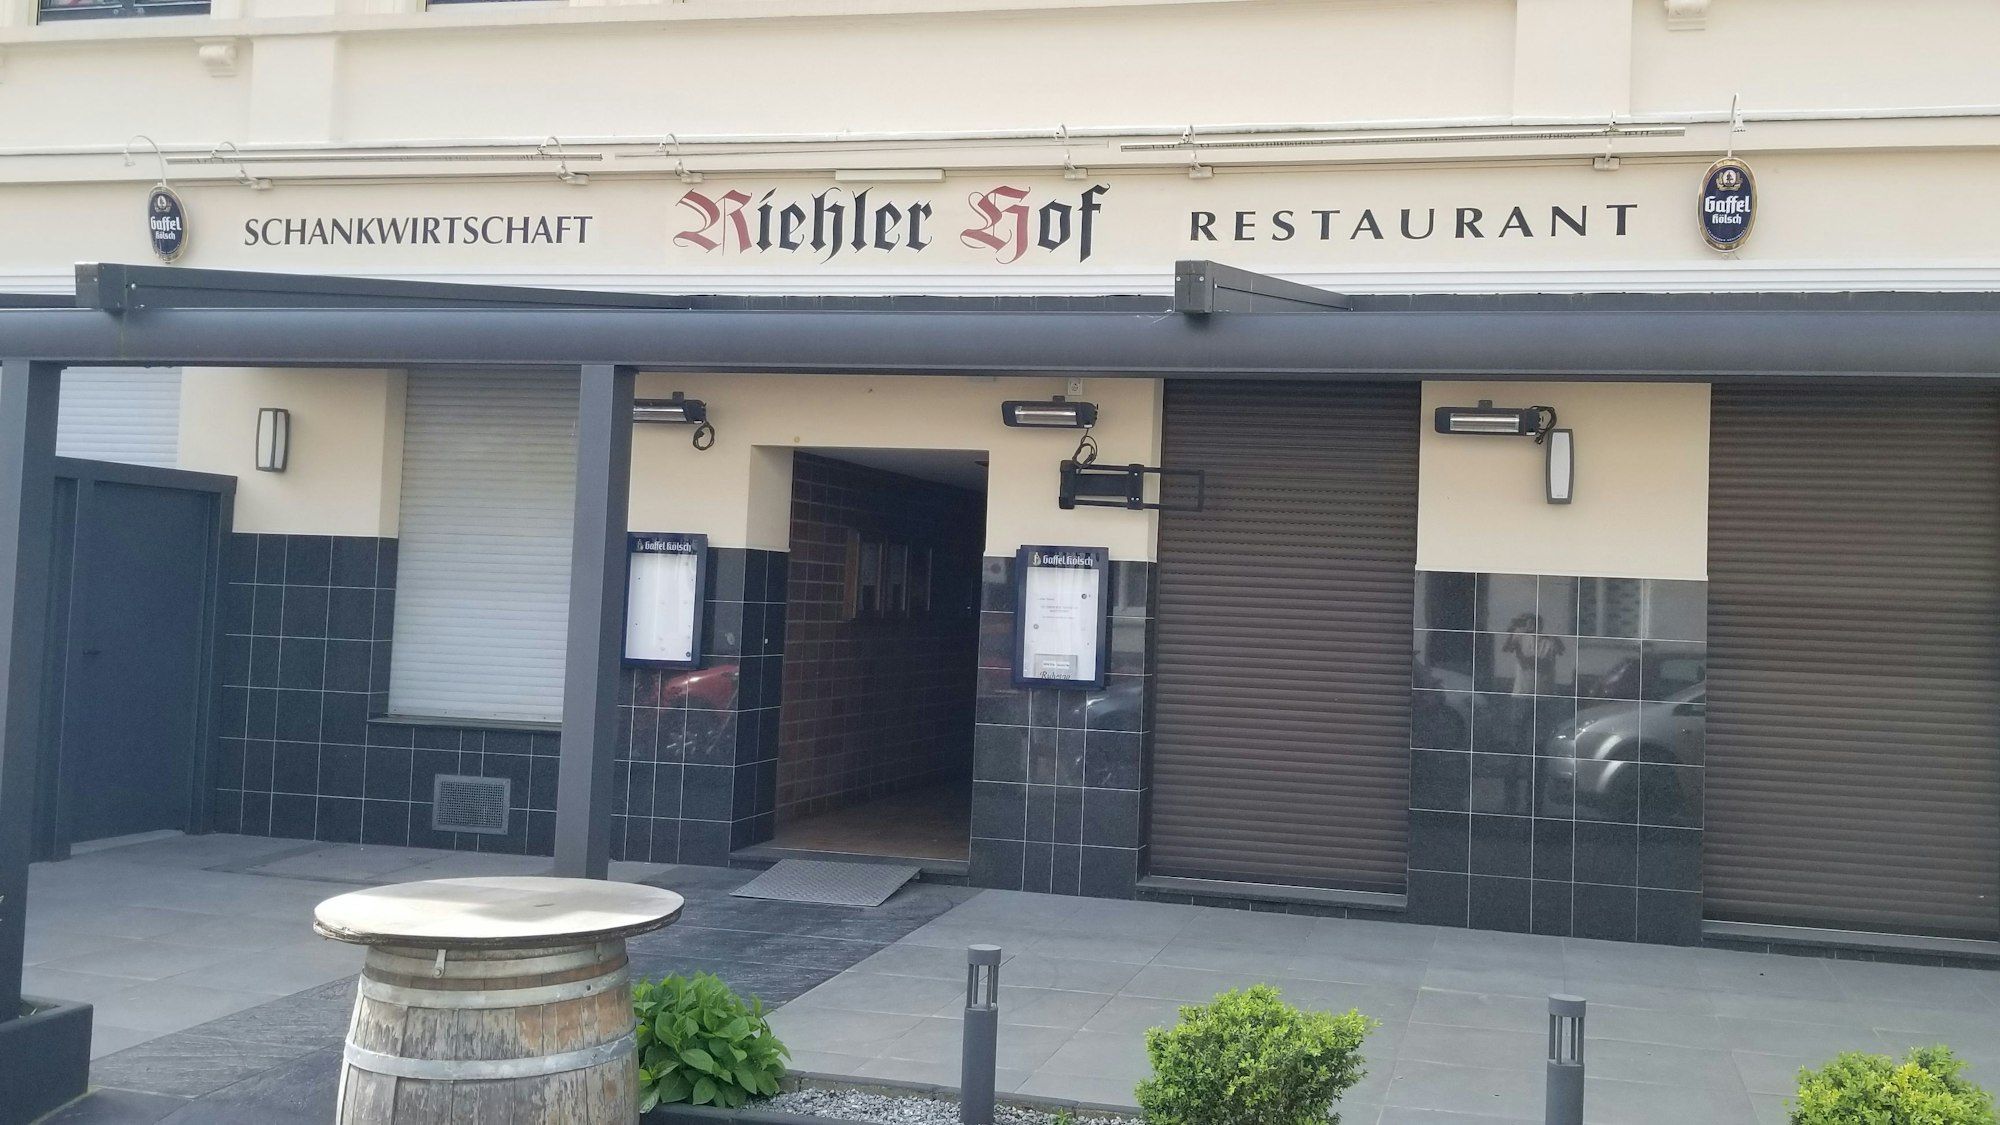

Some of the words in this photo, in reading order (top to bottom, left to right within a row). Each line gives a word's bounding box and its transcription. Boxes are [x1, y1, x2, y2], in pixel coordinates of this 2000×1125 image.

[1704, 195, 1751, 214] Gaffel
[150, 216, 182, 231] Gaffel
[673, 186, 933, 264] Riehler
[959, 183, 1110, 264] Hof
[1190, 204, 1638, 241] RESTAURANT
[1712, 213, 1742, 224] Kölsch
[244, 215, 593, 246] SCHANKWIRTSCHAFT
[644, 541, 666, 551] Gaffel
[1042, 554, 1066, 565] Gaffel
